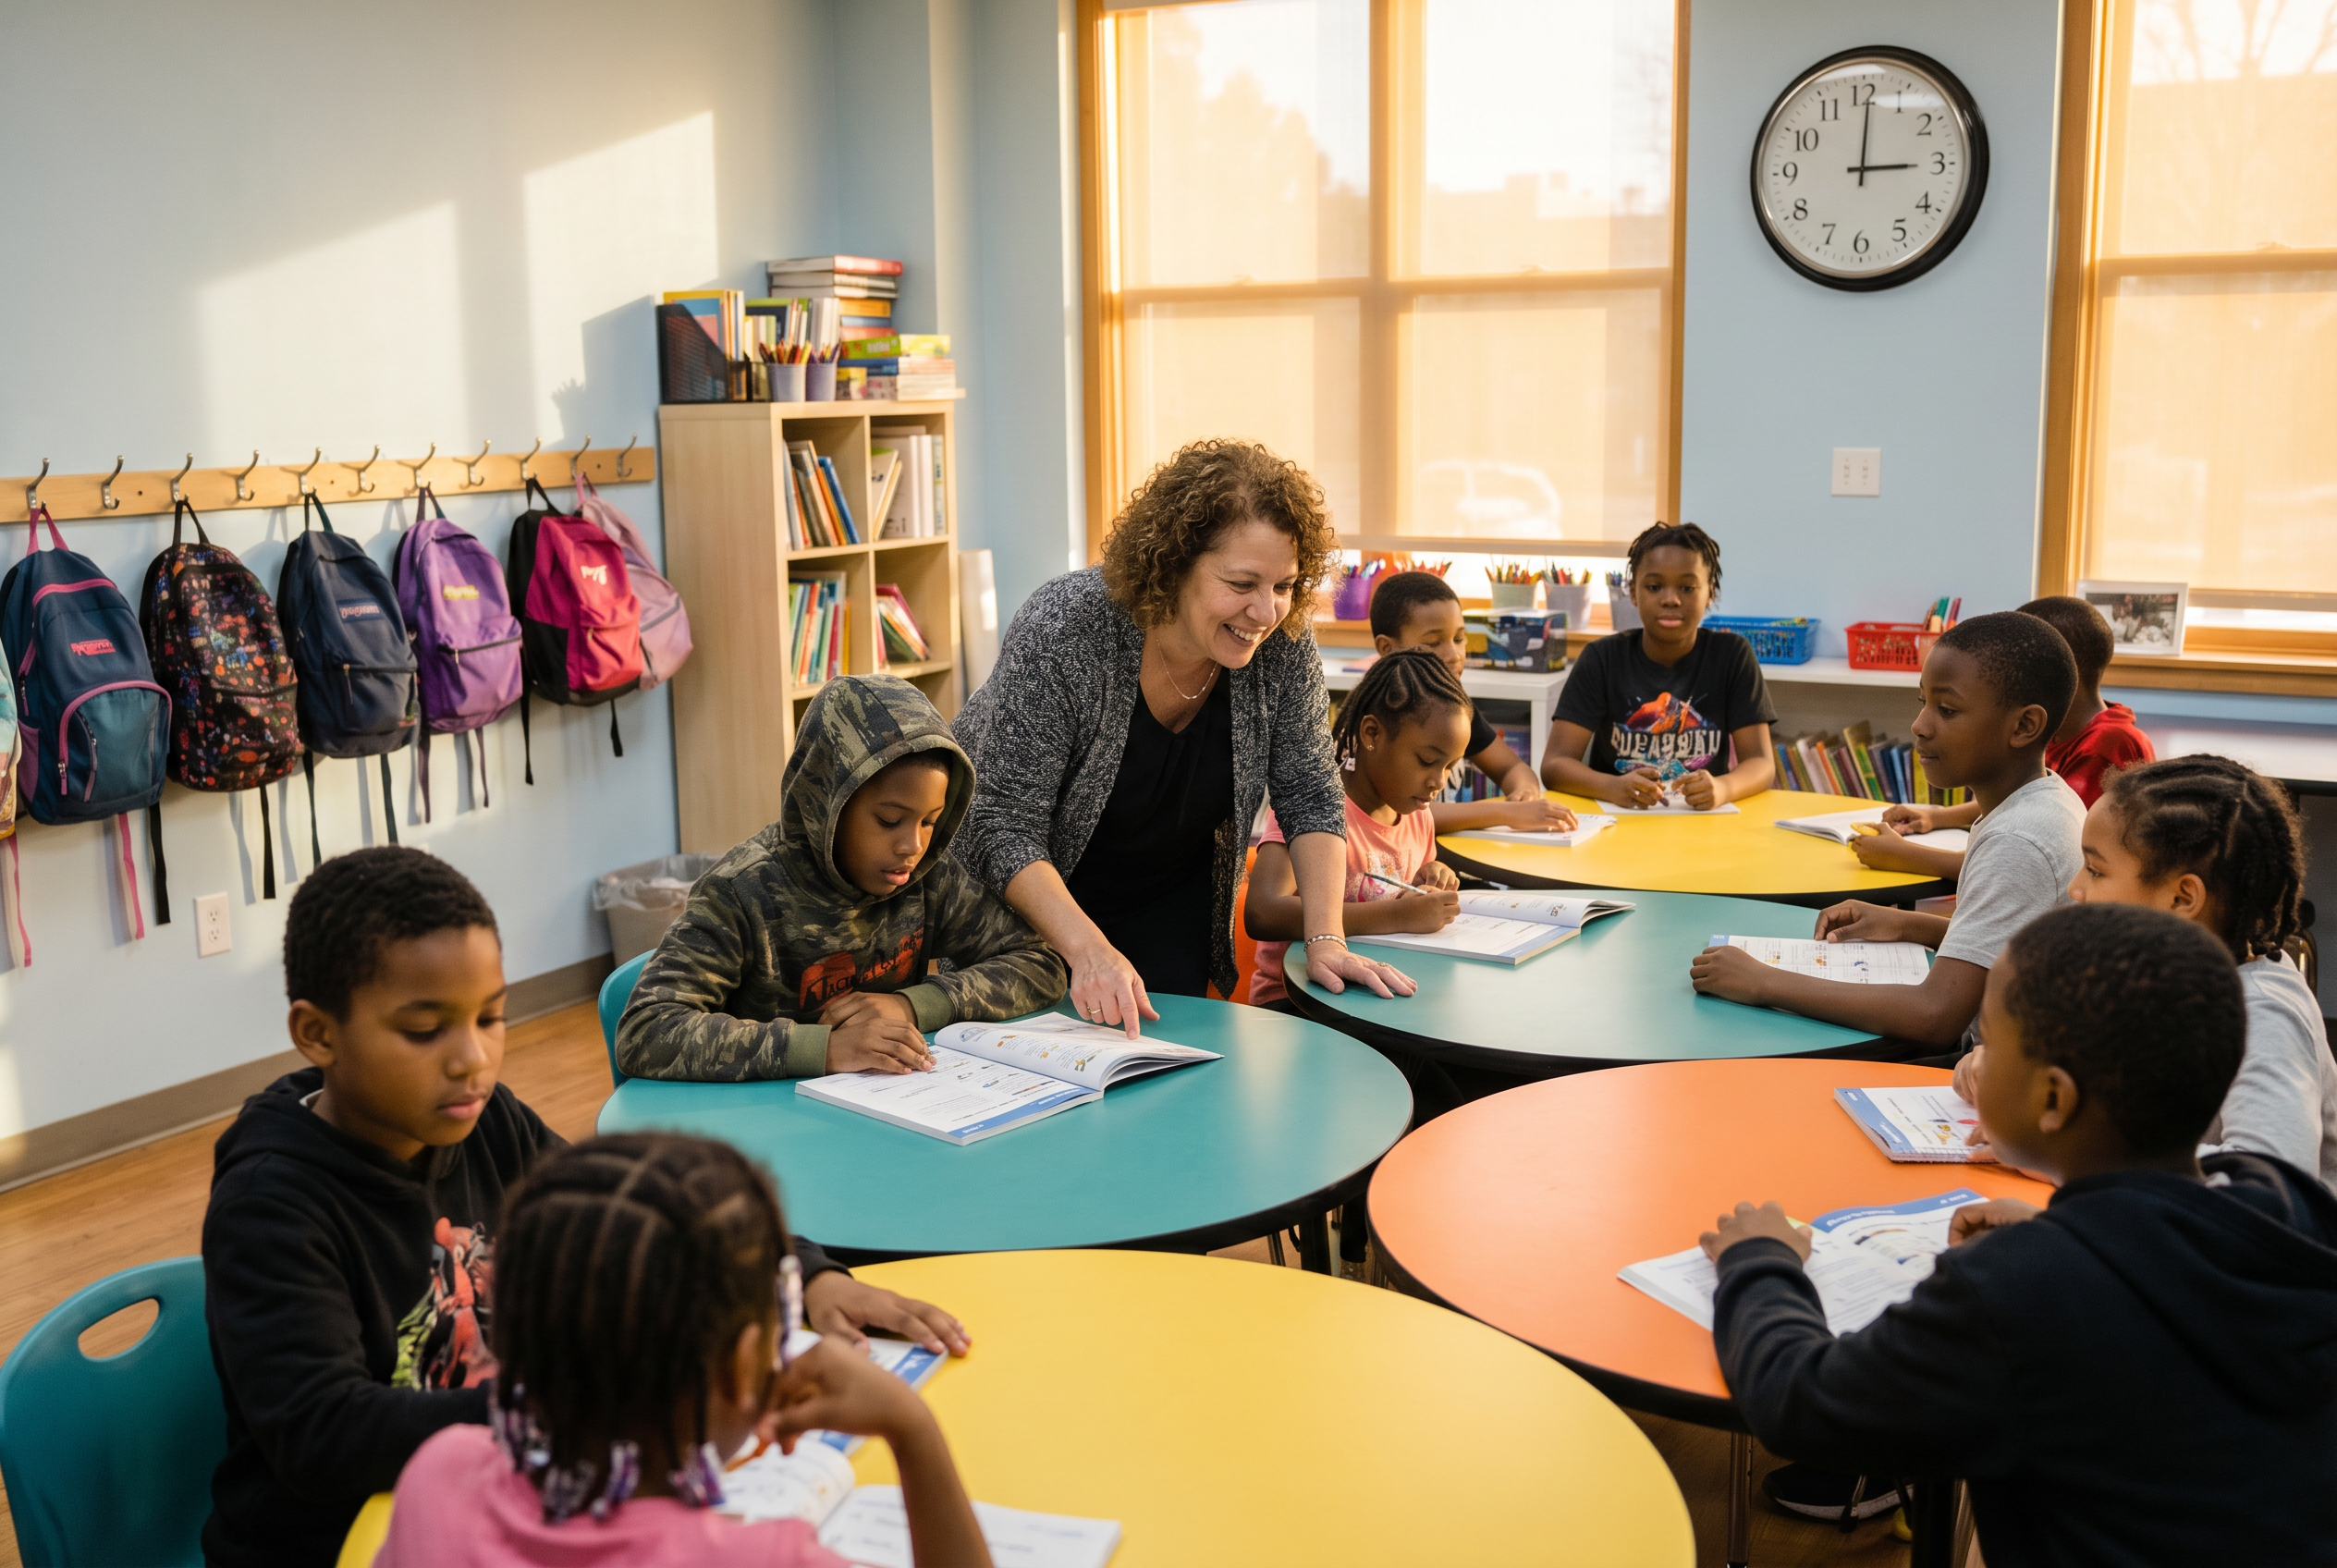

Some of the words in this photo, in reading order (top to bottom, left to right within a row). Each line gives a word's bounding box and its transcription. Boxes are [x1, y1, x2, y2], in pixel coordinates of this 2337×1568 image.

[1850, 83, 1877, 107] 12
[1895, 90, 1904, 114] 1
[1819, 98, 1841, 122] 11
[1916, 113, 1932, 136] 2
[1793, 128, 1819, 153] 10
[1782, 162, 1798, 186] 9
[1929, 152, 1946, 175] 3
[1793, 198, 1808, 221] 8
[1915, 190, 1932, 214] 4
[1821, 223, 1836, 245] 7
[1854, 229, 1870, 254] 6
[1891, 218, 1906, 242] 5
